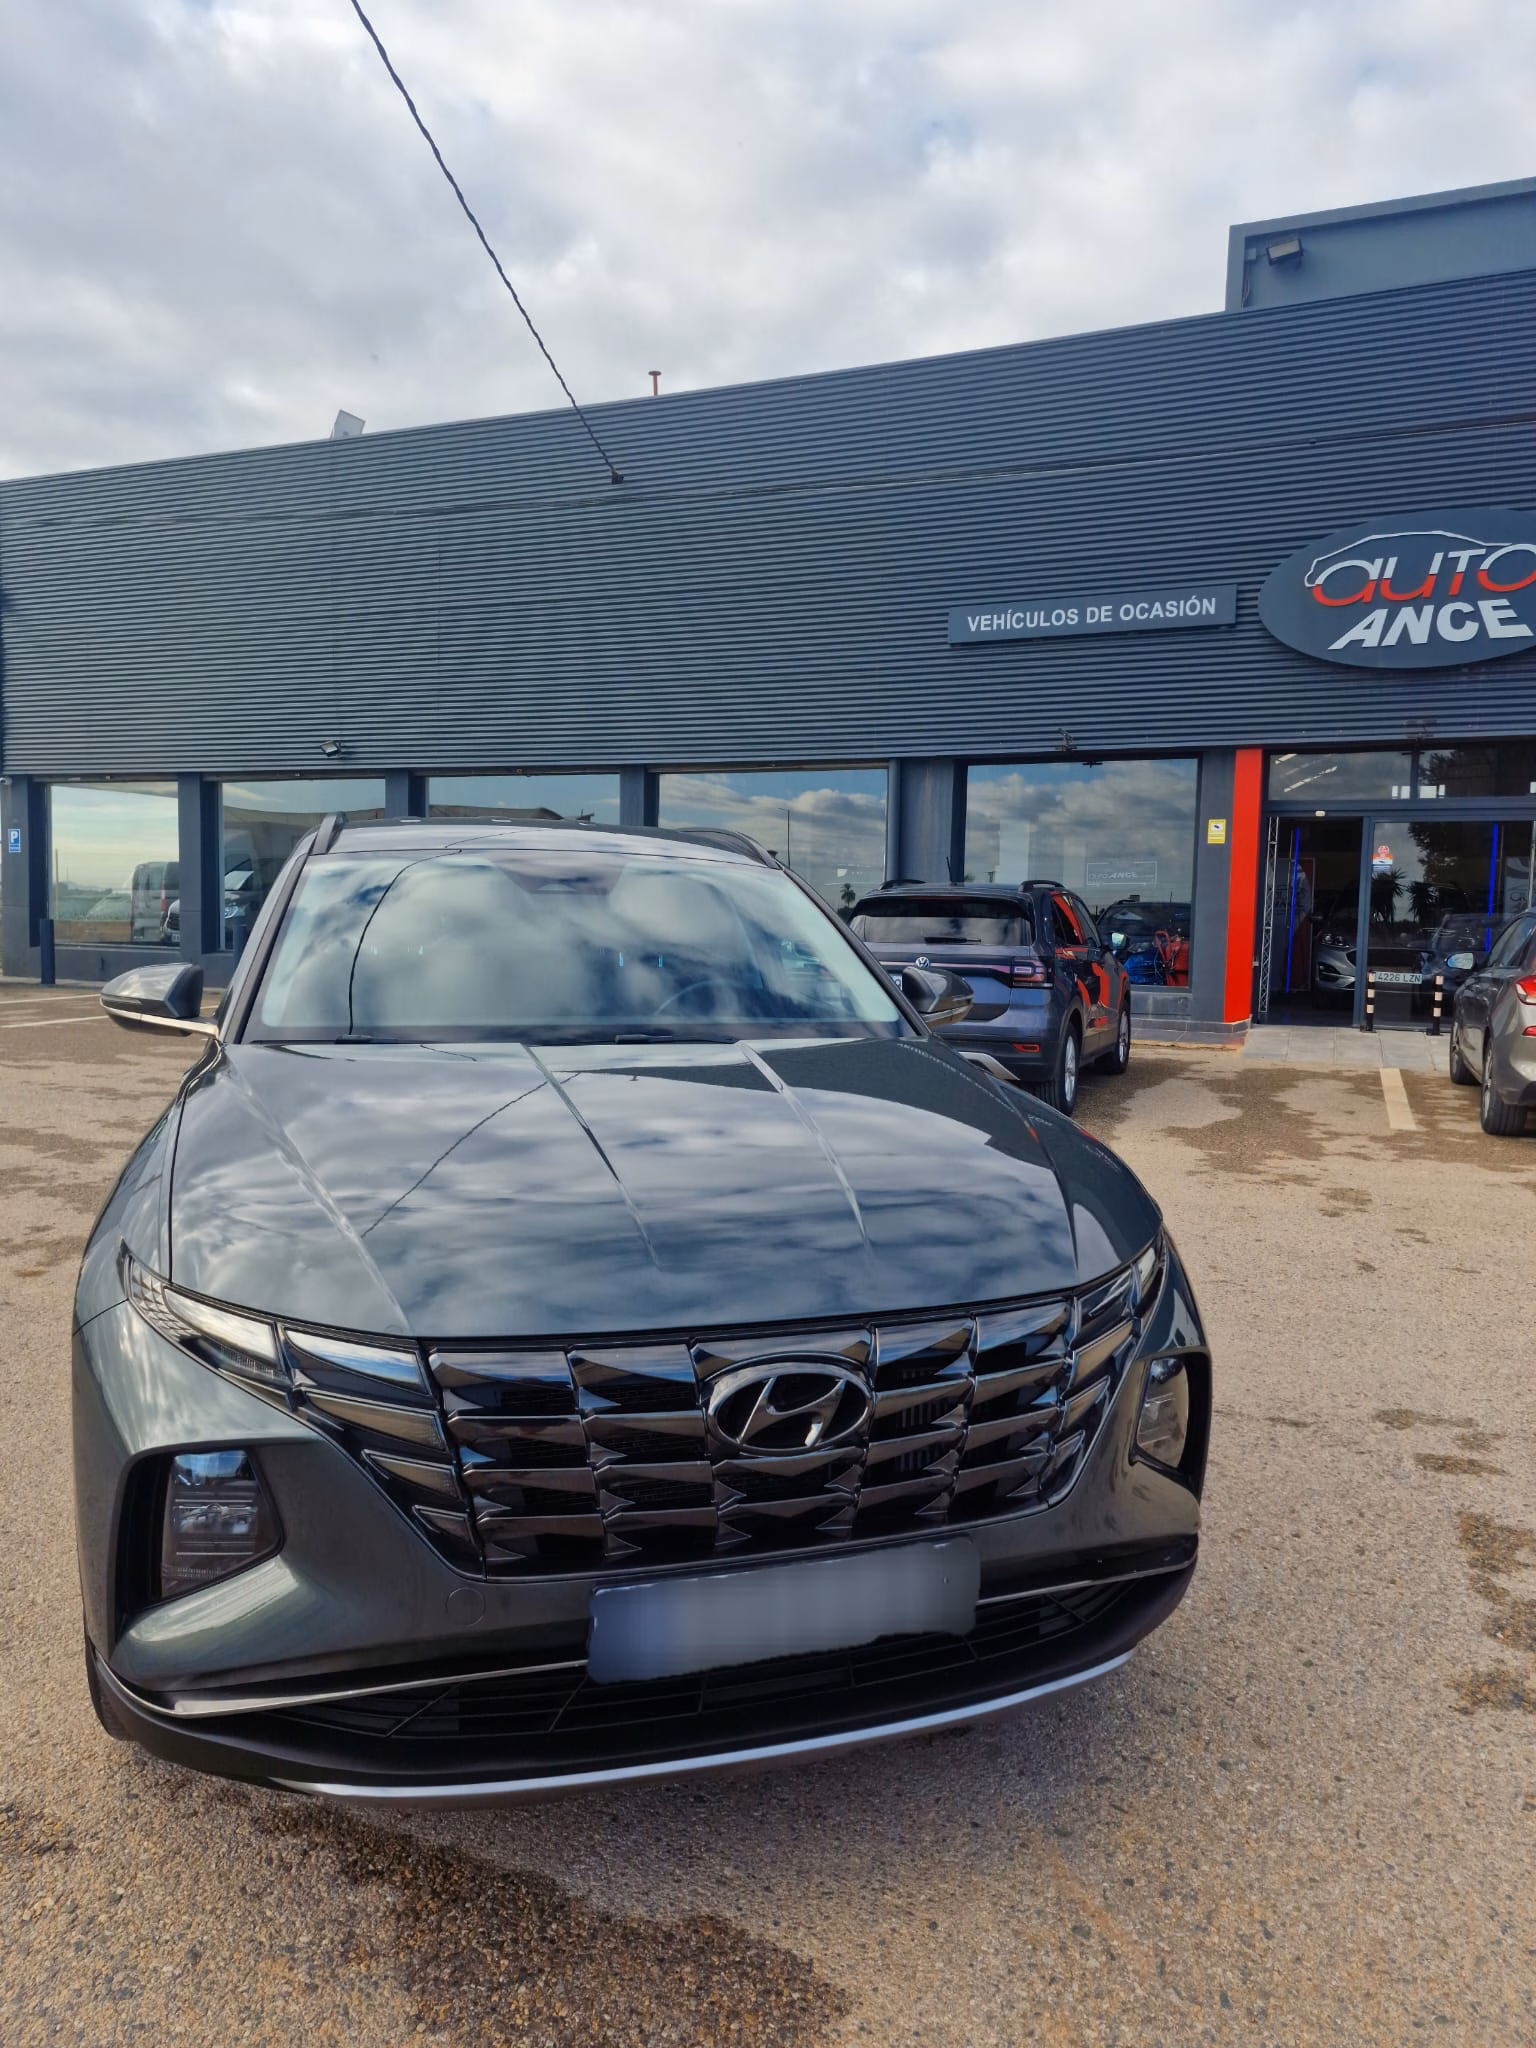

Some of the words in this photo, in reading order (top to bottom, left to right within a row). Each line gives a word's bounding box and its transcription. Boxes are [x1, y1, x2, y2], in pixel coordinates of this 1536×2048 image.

[967, 608, 1078, 632] VEHÍCULOS
[1086, 605, 1113, 624] DE
[1119, 595, 1216, 621] OCASIÓN
[1327, 598, 1535, 650] ANCE
[10, 831, 18, 843] P
[1403, 974, 1421, 983] LZN
